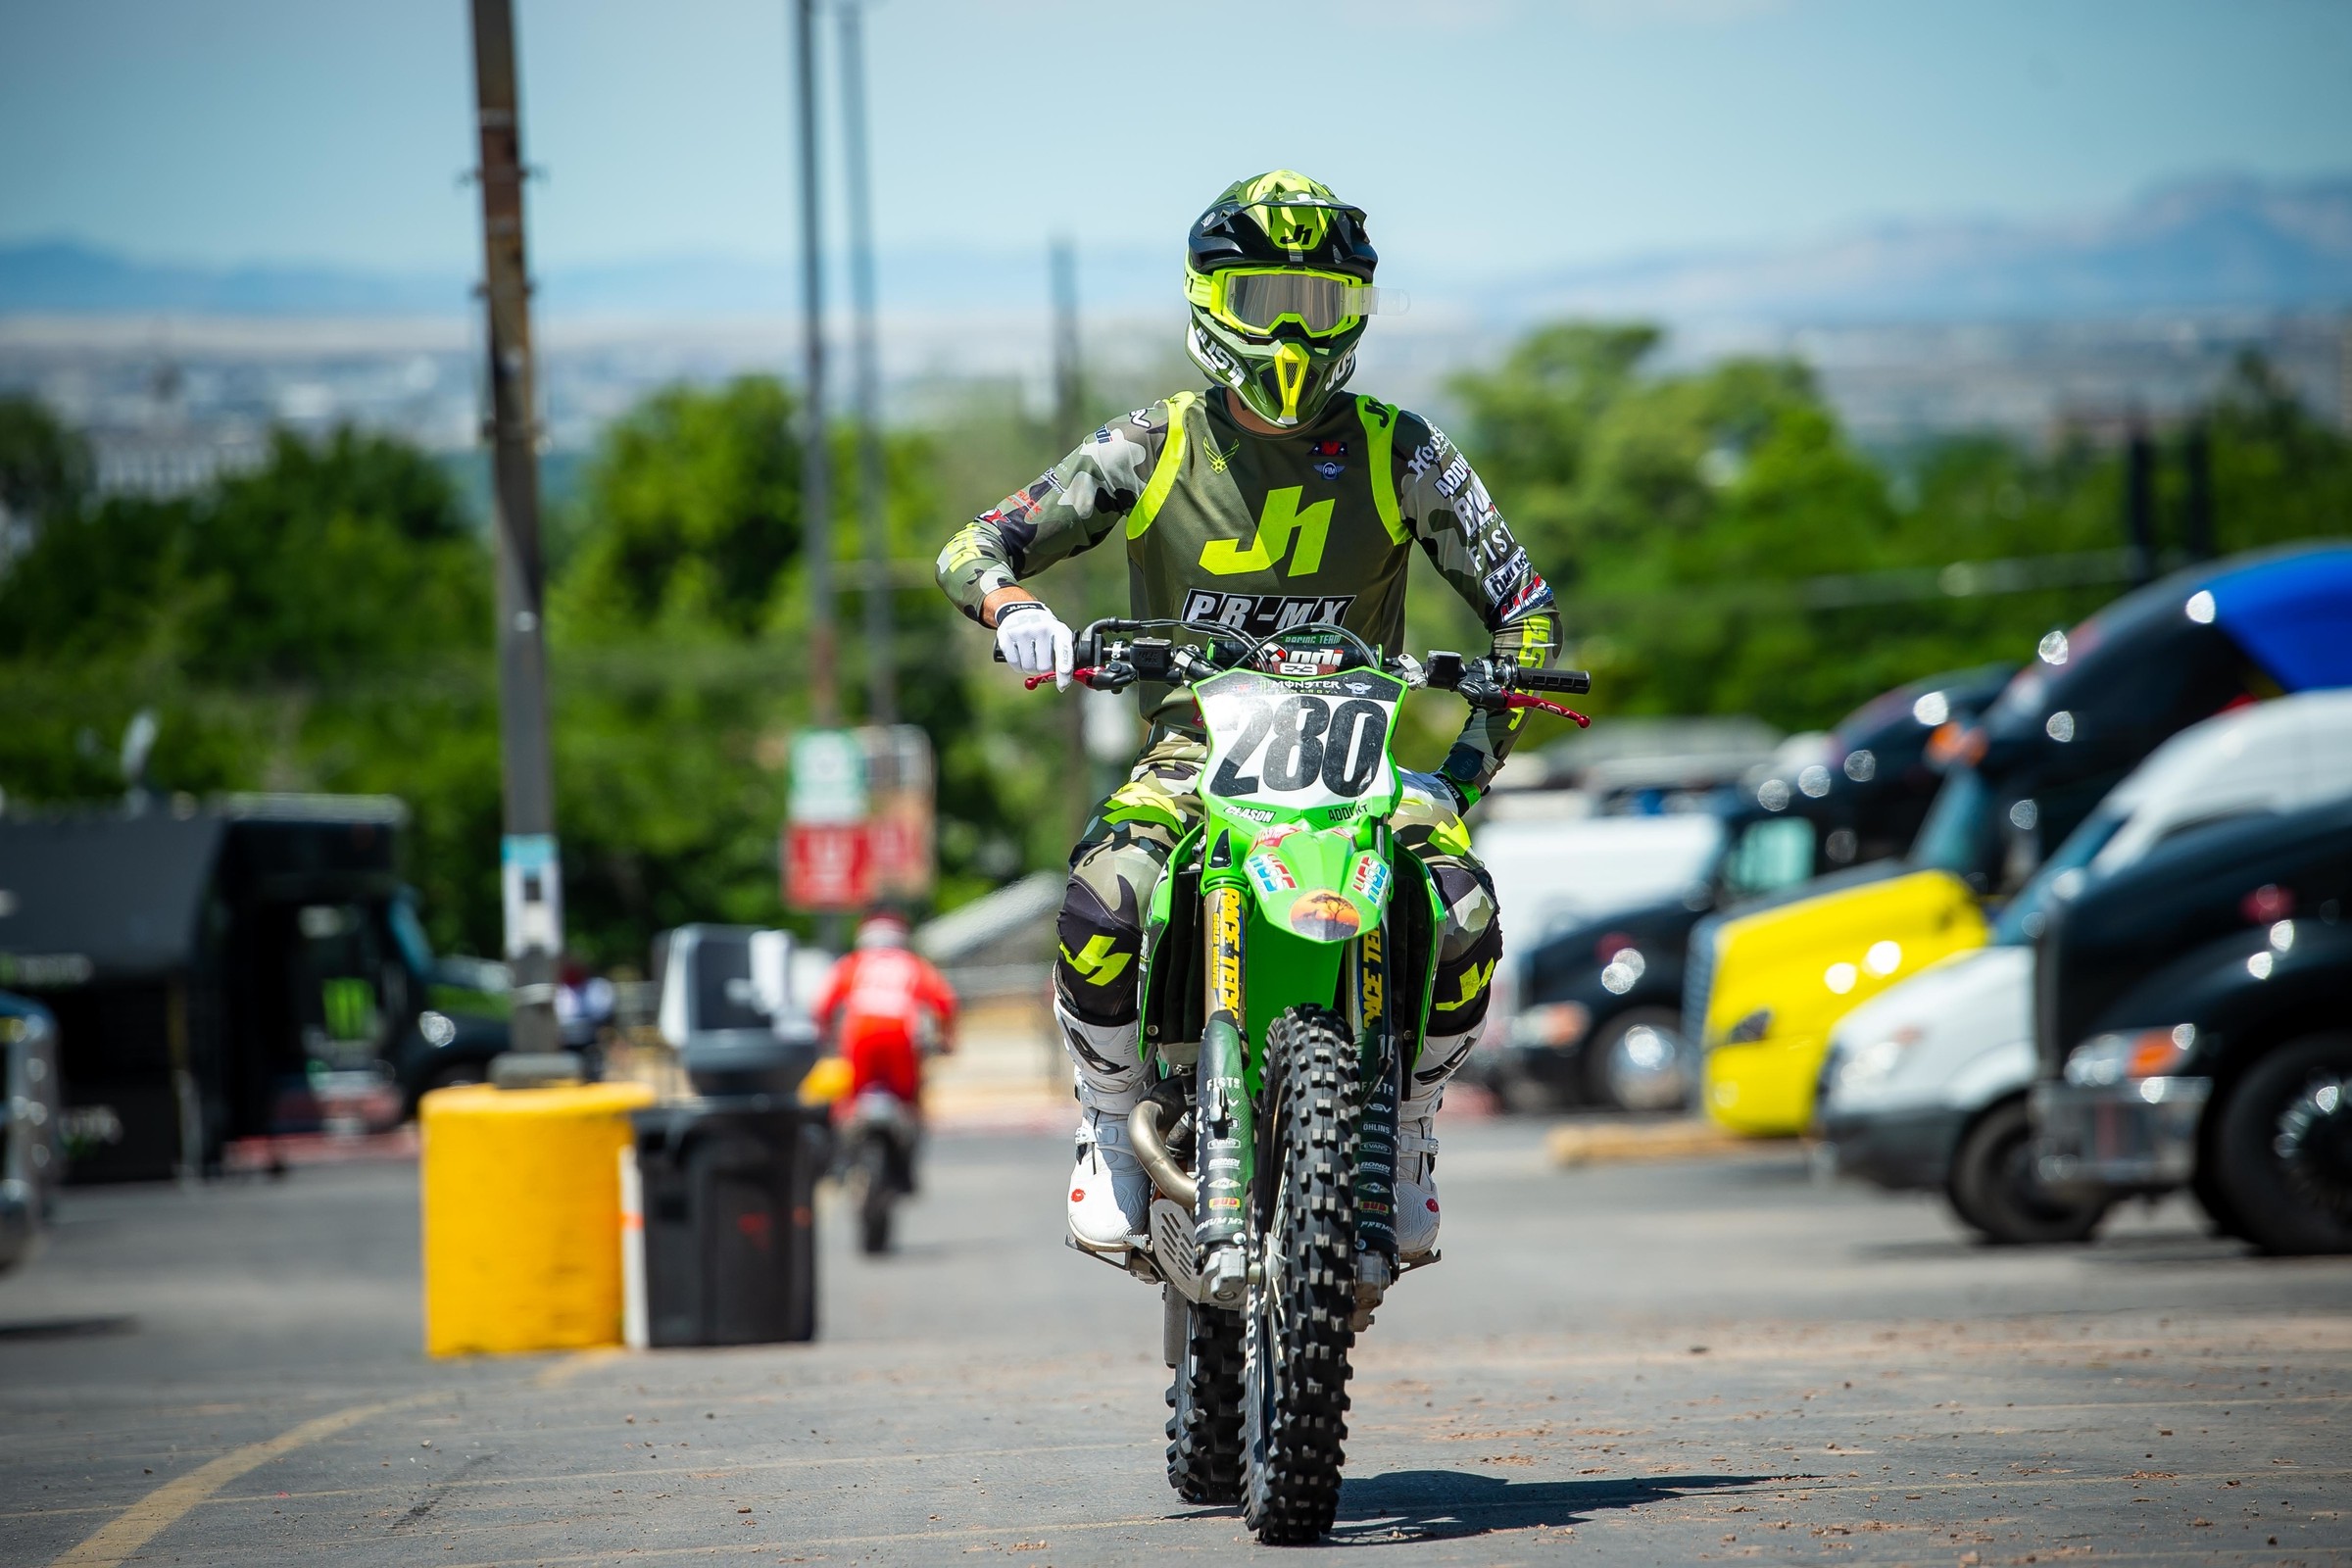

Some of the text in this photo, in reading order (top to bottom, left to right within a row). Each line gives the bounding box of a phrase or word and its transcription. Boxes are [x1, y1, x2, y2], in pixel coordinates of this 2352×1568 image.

[1186, 593, 1348, 631] PR-MX
[1273, 680, 1342, 690] MONSTER
[1209, 695, 1389, 799] 280
[1219, 887, 1241, 947] RACE
[1362, 1102, 1392, 1113] ASV
[1362, 1121, 1391, 1135] ÖHLINS
[1363, 1143, 1389, 1152] EVANS
[1360, 1161, 1391, 1171] BONDI
